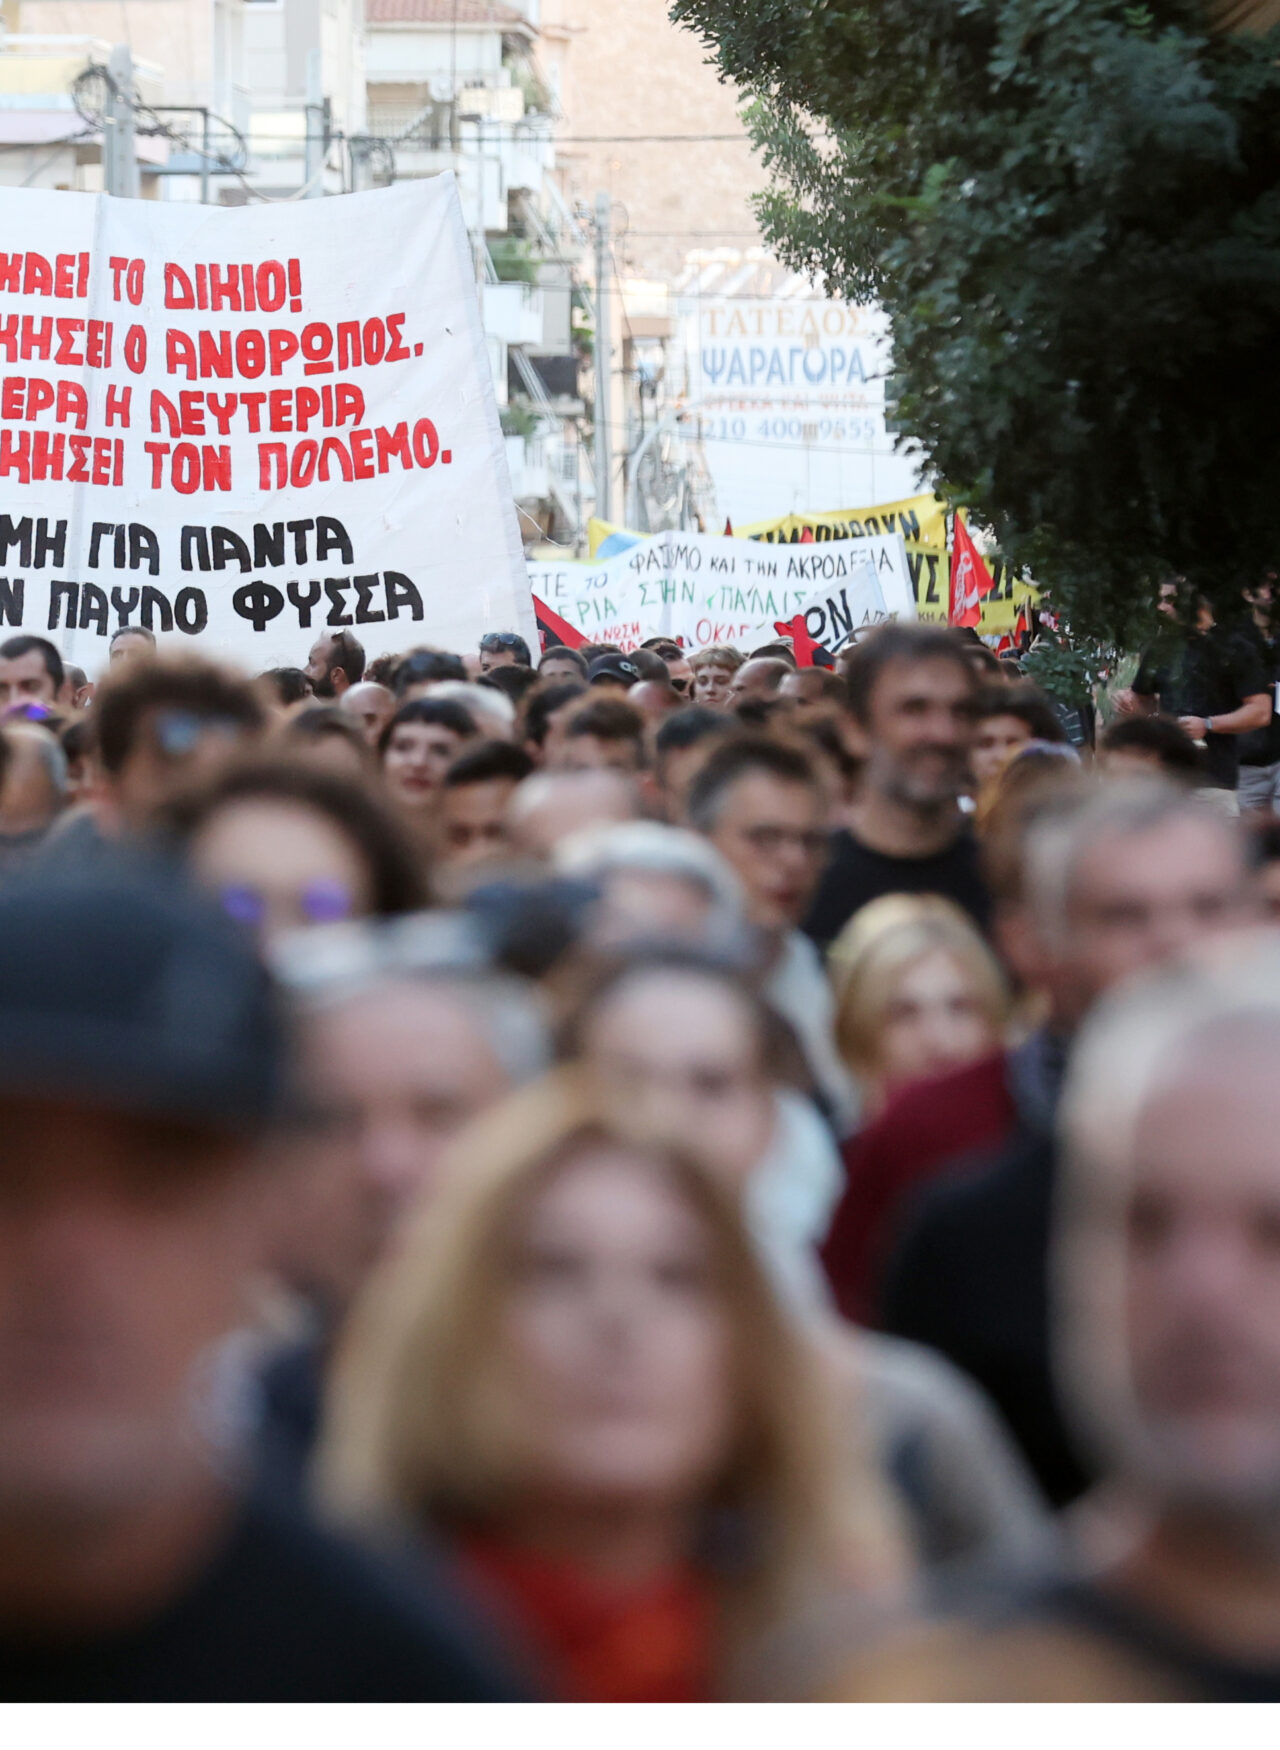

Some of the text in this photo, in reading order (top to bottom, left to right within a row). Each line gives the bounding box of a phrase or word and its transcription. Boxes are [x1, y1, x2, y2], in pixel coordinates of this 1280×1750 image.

[109, 256, 145, 306] ΤΟ
[164, 258, 302, 312] ΔΙΚΙΟ!
[124, 324, 147, 374] Ο
[702, 347, 867, 385] ΨΑΡΑΓΟΡΑ
[105, 384, 132, 427] Η
[150, 383, 366, 437] ΛΕΥΤΕΡΙΑ
[144, 442, 231, 494] ΤΟΝ
[89, 522, 160, 575] ΓΙΑ
[181, 516, 354, 574] ΠΑΝΤΑ
[584, 571, 609, 590] ΤΟ
[710, 556, 736, 574] ΚΑΙ
[744, 558, 778, 578] ΤΗΝ
[638, 579, 695, 607] ΣΤΗΝ
[47, 580, 208, 635] ΠΑΥΛΟ
[232, 570, 424, 632] ΦΥΣΣΑ
